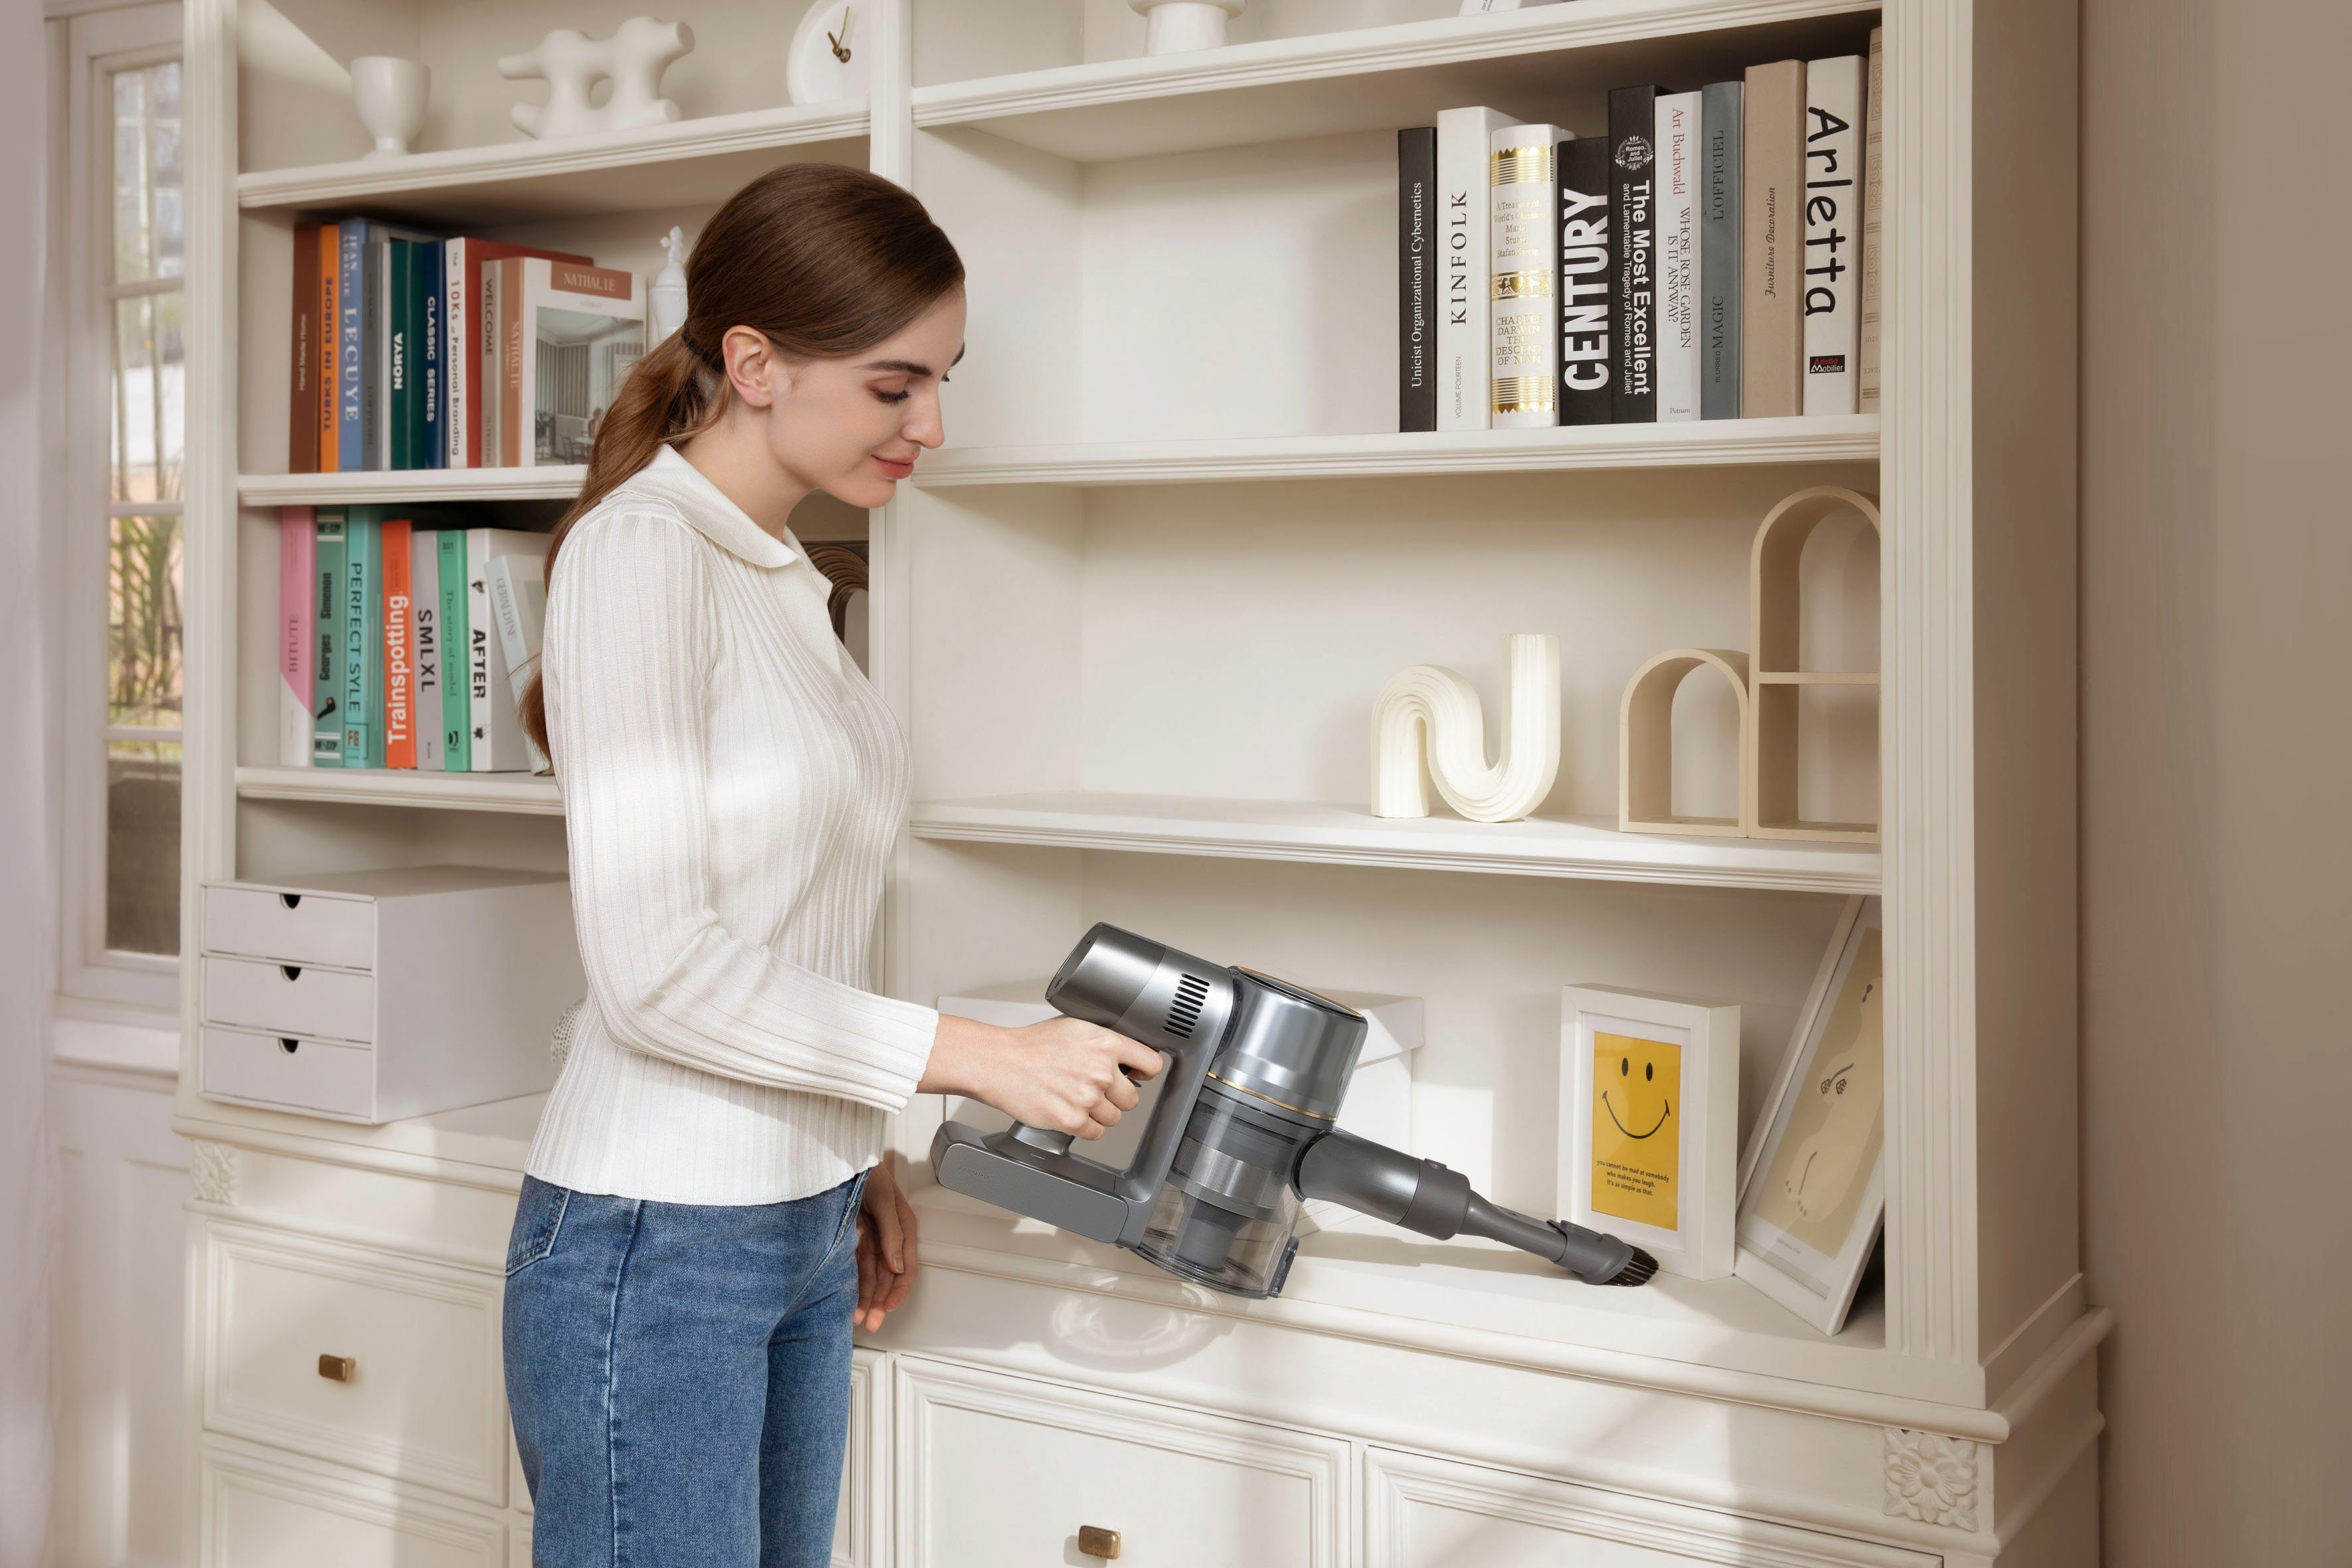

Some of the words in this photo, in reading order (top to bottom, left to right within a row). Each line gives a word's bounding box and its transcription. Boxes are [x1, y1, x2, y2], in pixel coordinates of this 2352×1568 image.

[1672, 108, 1684, 128] Art
[1673, 133, 1686, 195] Buchwald
[1713, 131, 1724, 221] L'OFFICIEL
[1411, 182, 1425, 252] Cybernetics
[1494, 212, 1514, 223] World's
[1496, 201, 1501, 211] A
[1532, 198, 1540, 207] of
[1632, 180, 1650, 222] The
[1766, 187, 1776, 244] Decoration
[1805, 106, 1853, 317] Arletta
[1623, 203, 1632, 258] Lamentable
[1668, 235, 1678, 245] IS
[1680, 206, 1690, 255] WHOSE
[1451, 190, 1467, 325] KINFOLK
[1622, 260, 1632, 299] Tragedy
[1633, 230, 1650, 285] Most
[1668, 250, 1678, 262] IT
[1680, 260, 1690, 291] ROSE
[1765, 247, 1776, 297] Furniture
[564, 271, 616, 292] NATHALIE
[1411, 255, 1425, 342] Organizational
[1563, 188, 1609, 391] CENTURY
[1624, 301, 1632, 310] of
[1668, 267, 1678, 323] ANYWAY?
[325, 276, 334, 344] EUROPE
[427, 296, 436, 360] CLASSIC
[485, 279, 494, 356] WELCOME
[1496, 315, 1544, 325] CHARLES
[1498, 325, 1541, 335] DARWIN
[1681, 295, 1691, 348] GARDEN
[1713, 296, 1724, 349] MAGIC
[325, 351, 332, 370] IN
[1496, 345, 1545, 356] DESCENT
[1498, 356, 1510, 365] OF
[1514, 356, 1541, 364] MAN
[1507, 335, 1529, 345] THE
[1634, 291, 1651, 395] Excellent
[345, 308, 358, 421] LECUYE
[1411, 345, 1422, 387] Unicist
[426, 368, 436, 422] SERIES
[320, 572, 332, 619] Simenon
[351, 563, 362, 657] PERFECT
[446, 591, 455, 610] The
[418, 609, 435, 692] SMLXL
[445, 615, 456, 645] story
[319, 634, 331, 680] Georges
[386, 595, 410, 745] Trainspotting
[449, 663, 457, 696] model
[473, 628, 486, 699] AFTER
[349, 665, 360, 712] SYLE
[1642, 1178, 1656, 1188] laugh.
[1646, 1172, 1670, 1183] somebody
